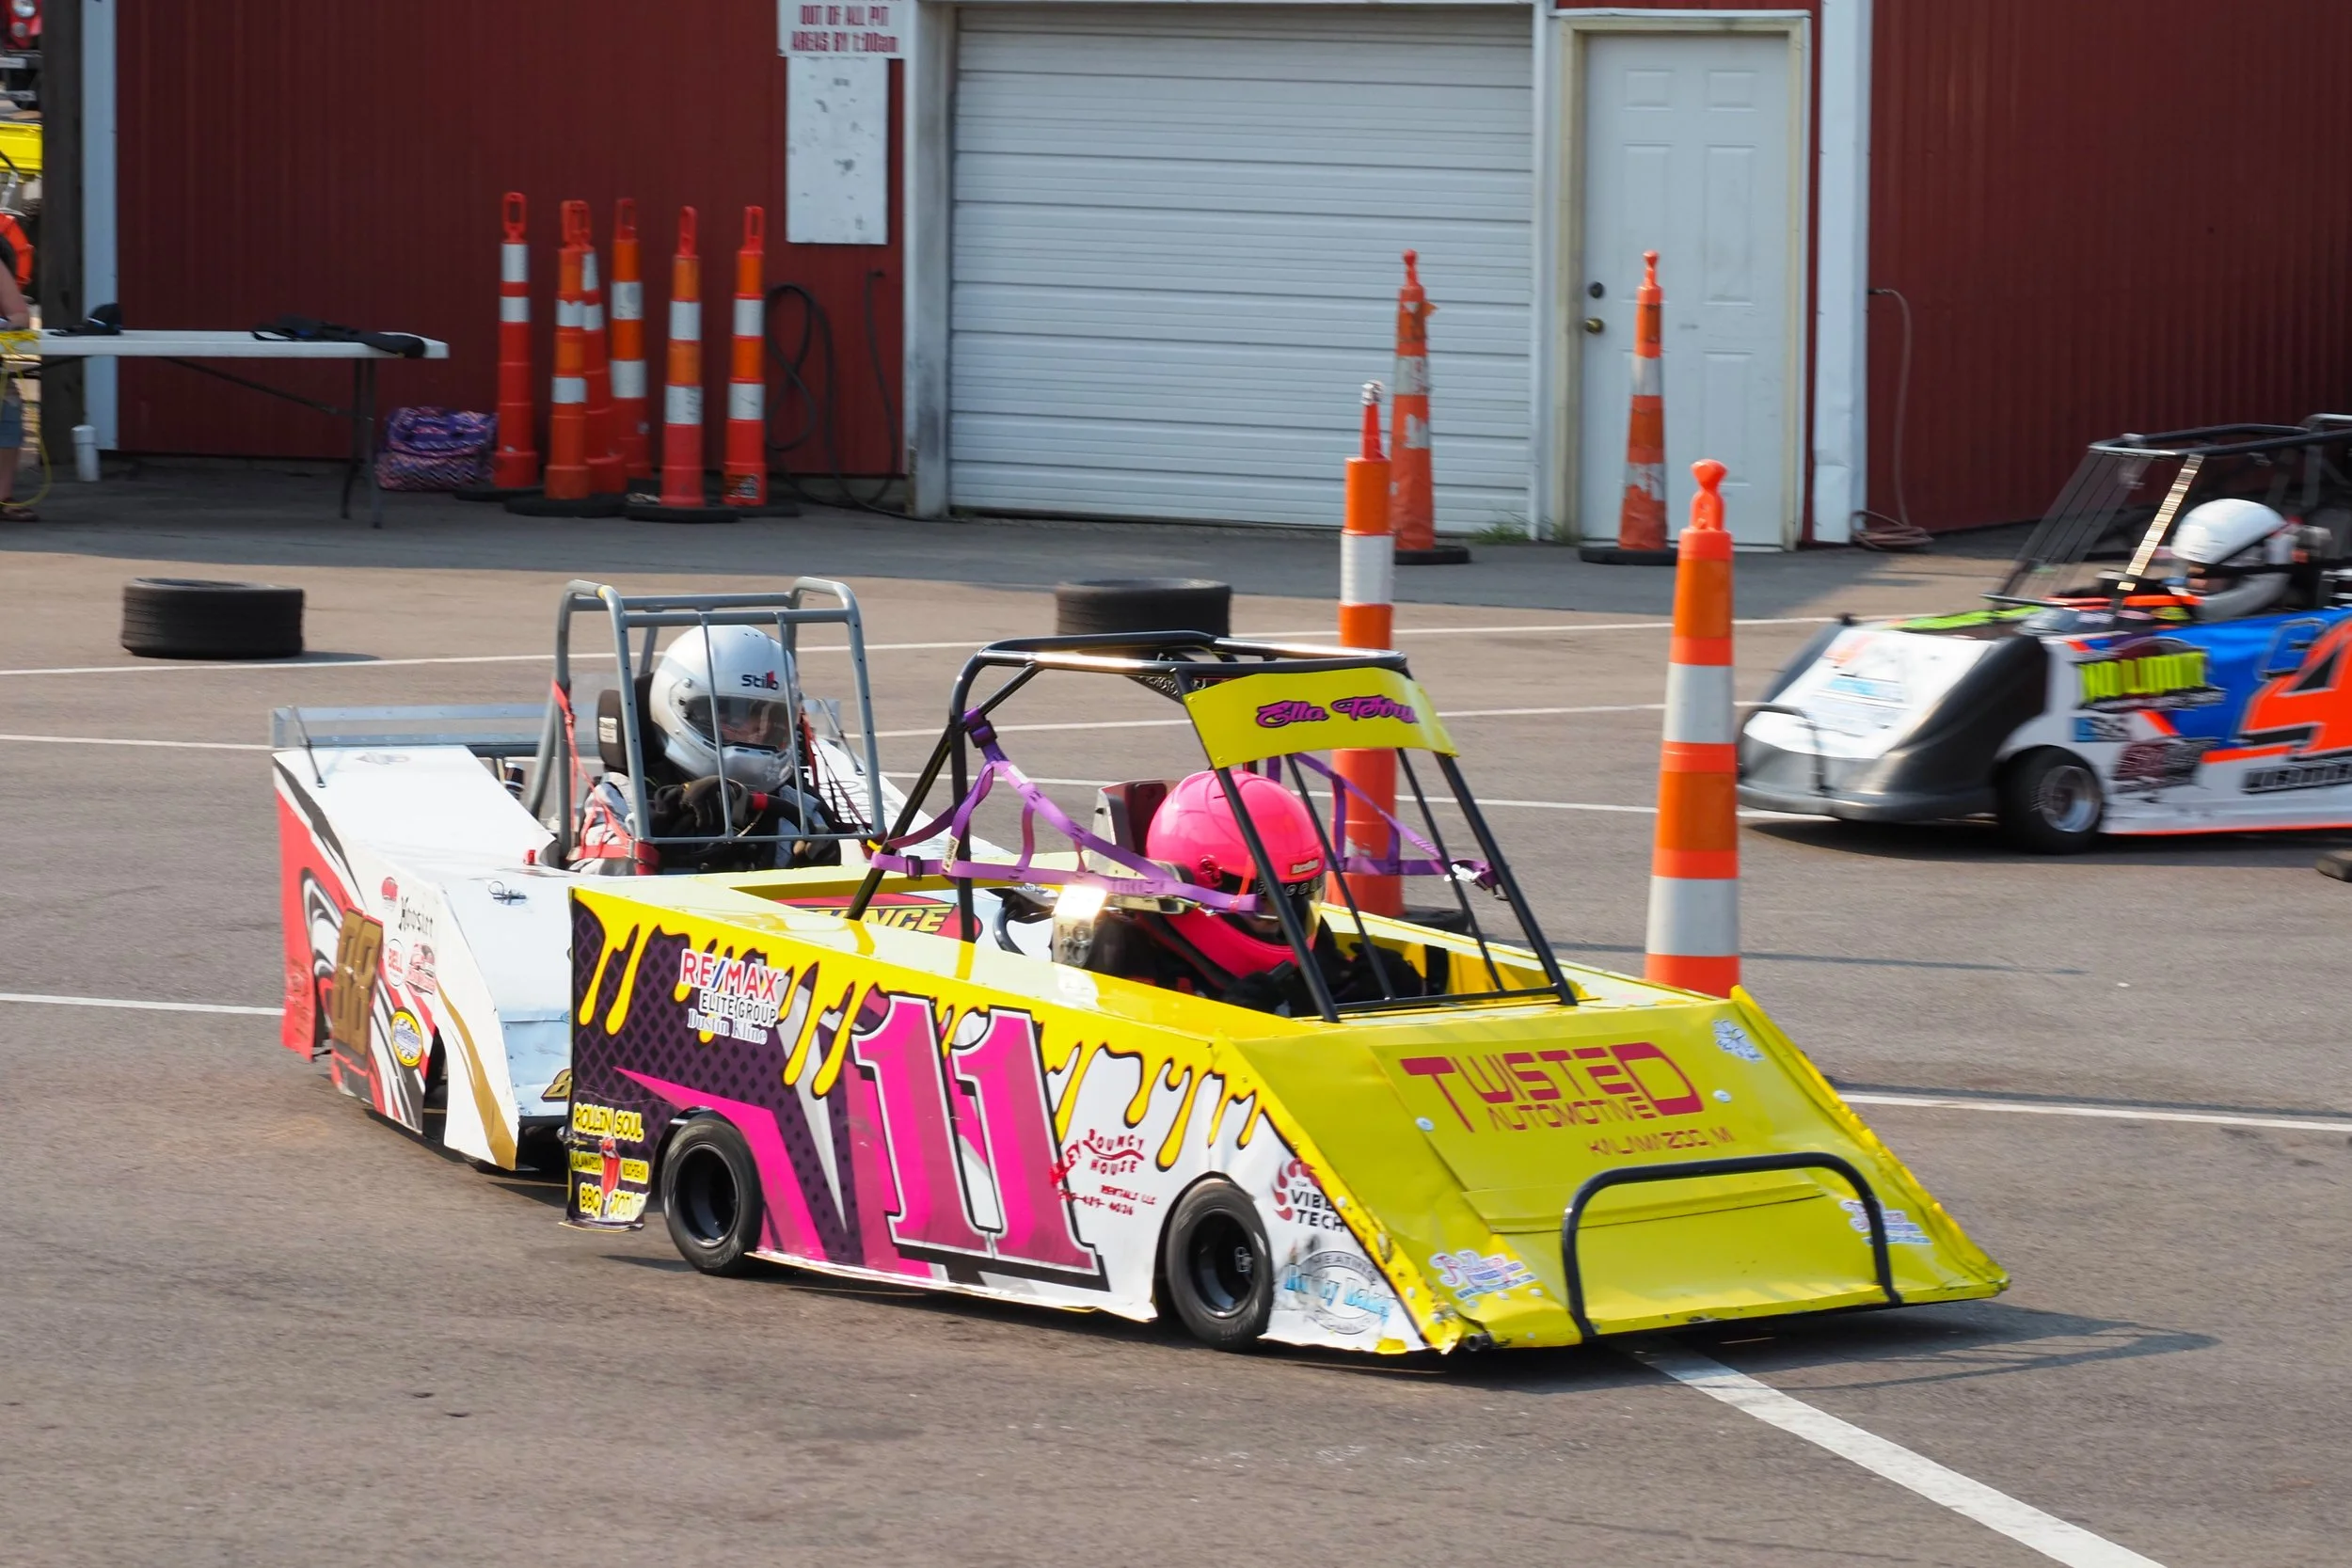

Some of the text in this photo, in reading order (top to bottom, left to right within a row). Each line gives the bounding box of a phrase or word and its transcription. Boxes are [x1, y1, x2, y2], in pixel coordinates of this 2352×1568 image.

[801, 5, 889, 26] OUT OF ALL PIT
[791, 31, 830, 52] AREAS
[834, 32, 849, 52] BY
[741, 673, 779, 691] Stilo
[1256, 695, 1420, 728] Ella Terry
[682, 952, 779, 1003] RE/MAX
[702, 992, 778, 1024] ELITE GROUP
[689, 1009, 767, 1043] Dustin Kline
[1400, 1041, 1705, 1133] TWISTED
[616, 1114, 643, 1138] SOUL
[1487, 1096, 1658, 1132] AUTOMOTIVE
[851, 991, 1103, 1279] 11
[1089, 1129, 1144, 1150] BOUNCY
[1090, 1159, 1137, 1176] HOUSE
[580, 1185, 601, 1214] BBQ
[1297, 1210, 1345, 1233] TECH
